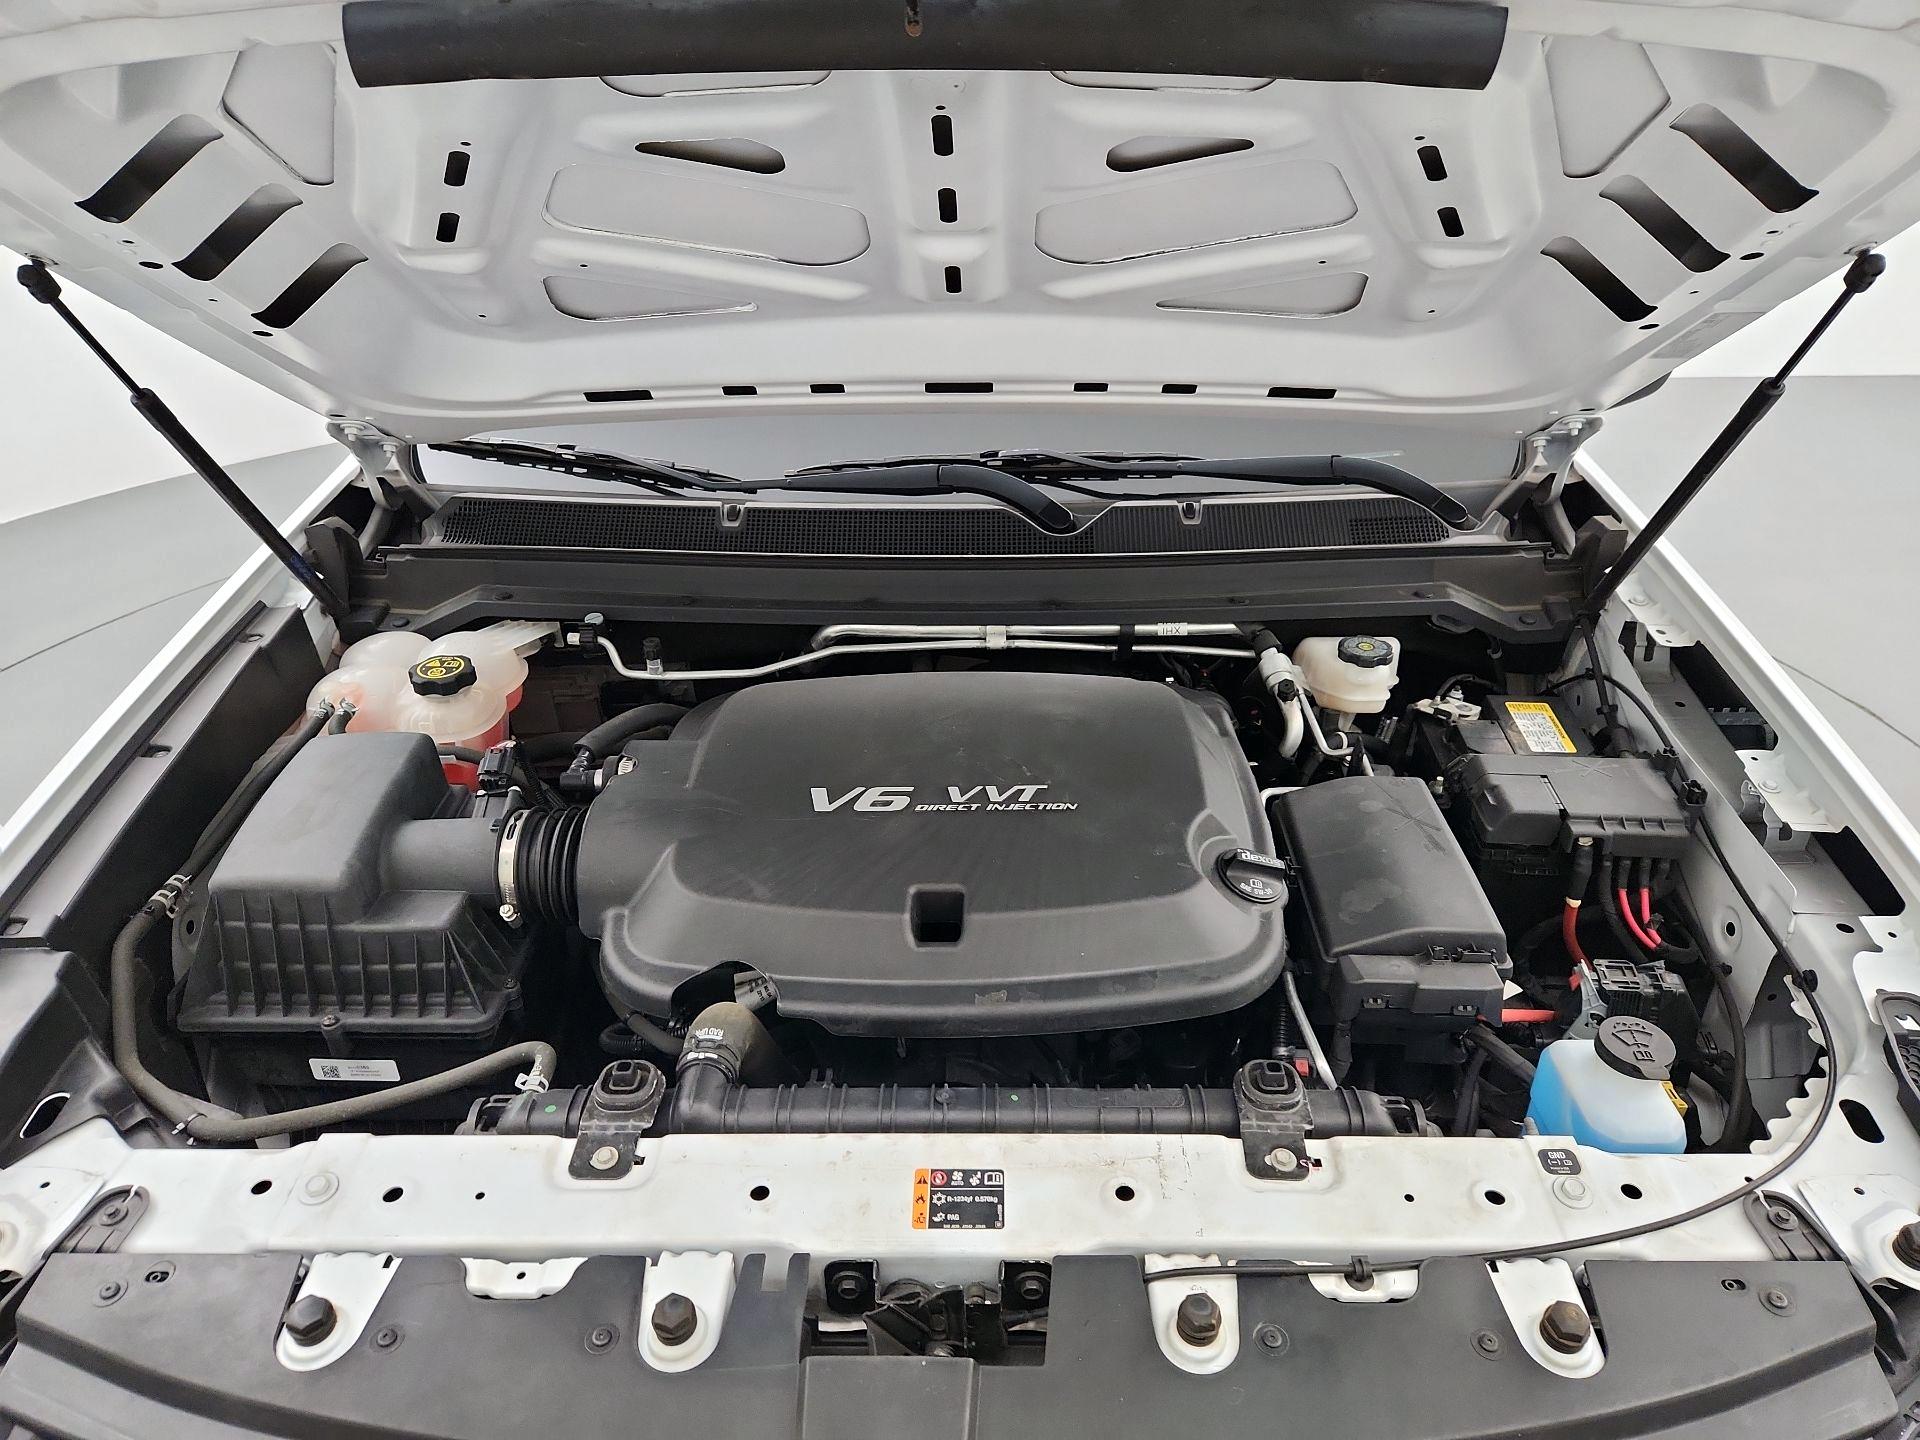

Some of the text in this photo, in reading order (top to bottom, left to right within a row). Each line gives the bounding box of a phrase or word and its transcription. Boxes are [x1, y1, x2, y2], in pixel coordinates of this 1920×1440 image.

[810, 784, 1049, 812] V6 VVT
[914, 803, 1078, 812] DIRECT INJECTION
[1547, 1151, 1566, 1159] GND
[946, 1213, 960, 1221] PAG
